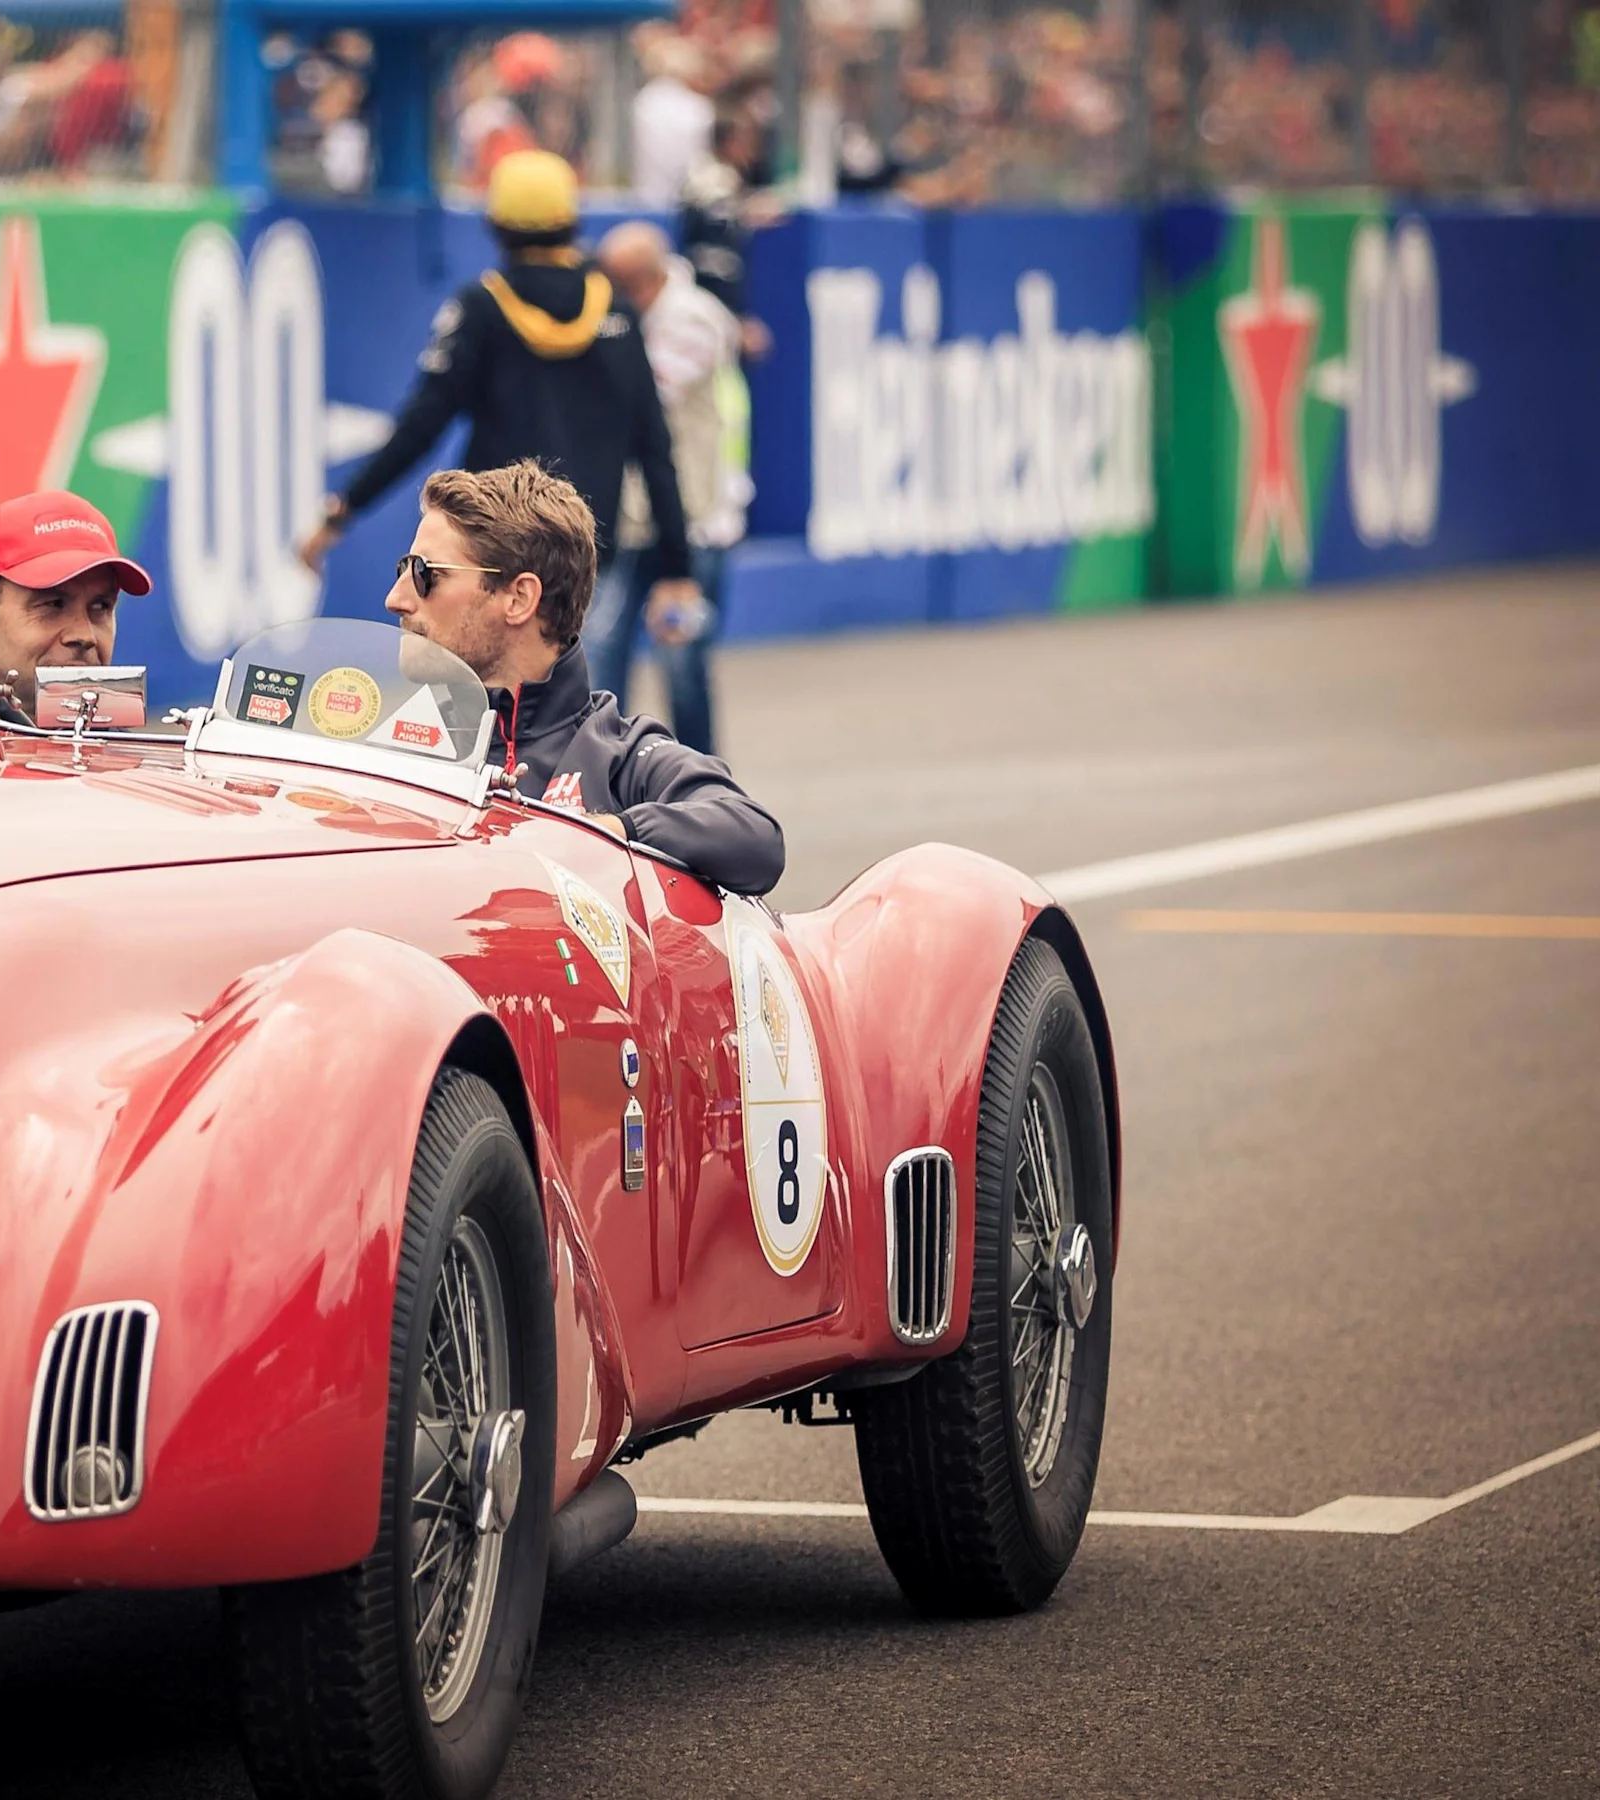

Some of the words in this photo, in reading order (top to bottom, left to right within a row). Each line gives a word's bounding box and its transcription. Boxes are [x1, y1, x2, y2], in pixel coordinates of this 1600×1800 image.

[806, 263, 1156, 560] Heineken
[253, 682, 295, 697] verificato
[255, 698, 281, 710] 1000
[331, 694, 356, 704] 1000
[250, 707, 281, 719] MIGLIA
[327, 702, 356, 712] MIGLIA
[402, 723, 430, 736] 1000
[398, 731, 430, 744] MIGLIA
[778, 1119, 799, 1225] 8
